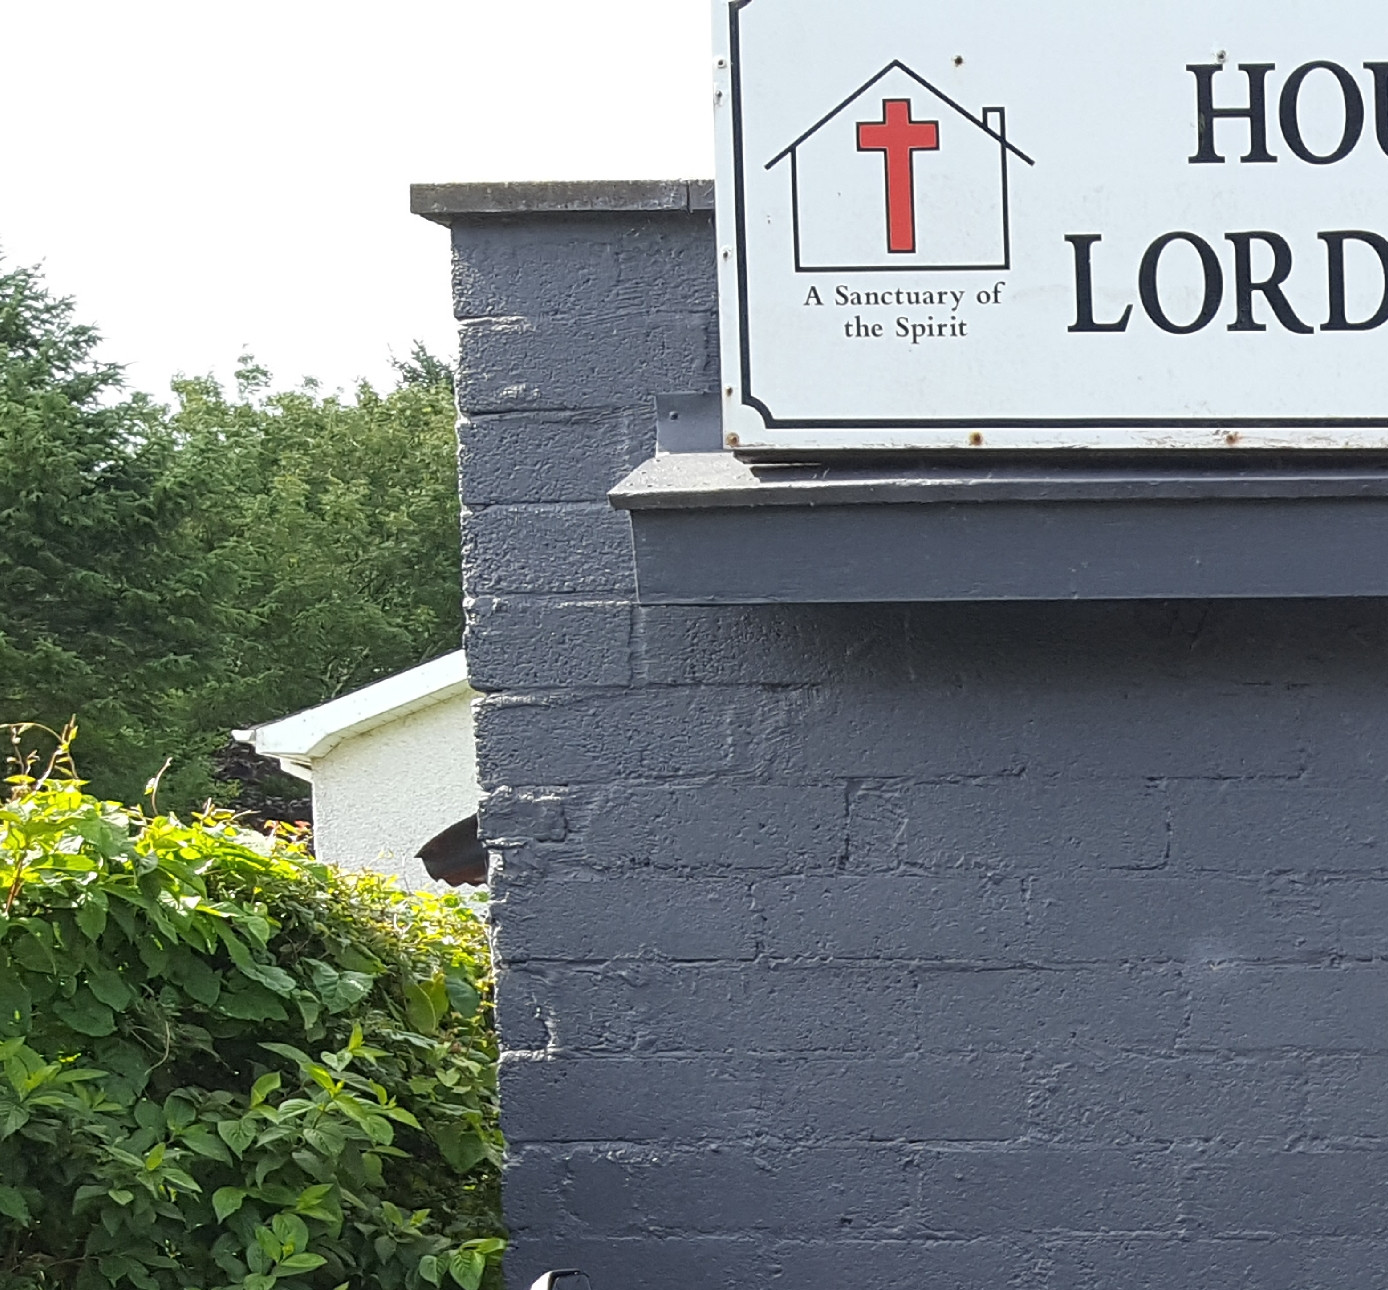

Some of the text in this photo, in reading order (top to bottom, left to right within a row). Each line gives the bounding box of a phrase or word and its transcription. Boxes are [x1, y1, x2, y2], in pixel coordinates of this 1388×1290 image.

[803, 281, 1006, 312] A Sanctuary of
[844, 315, 967, 345] the Spirit
